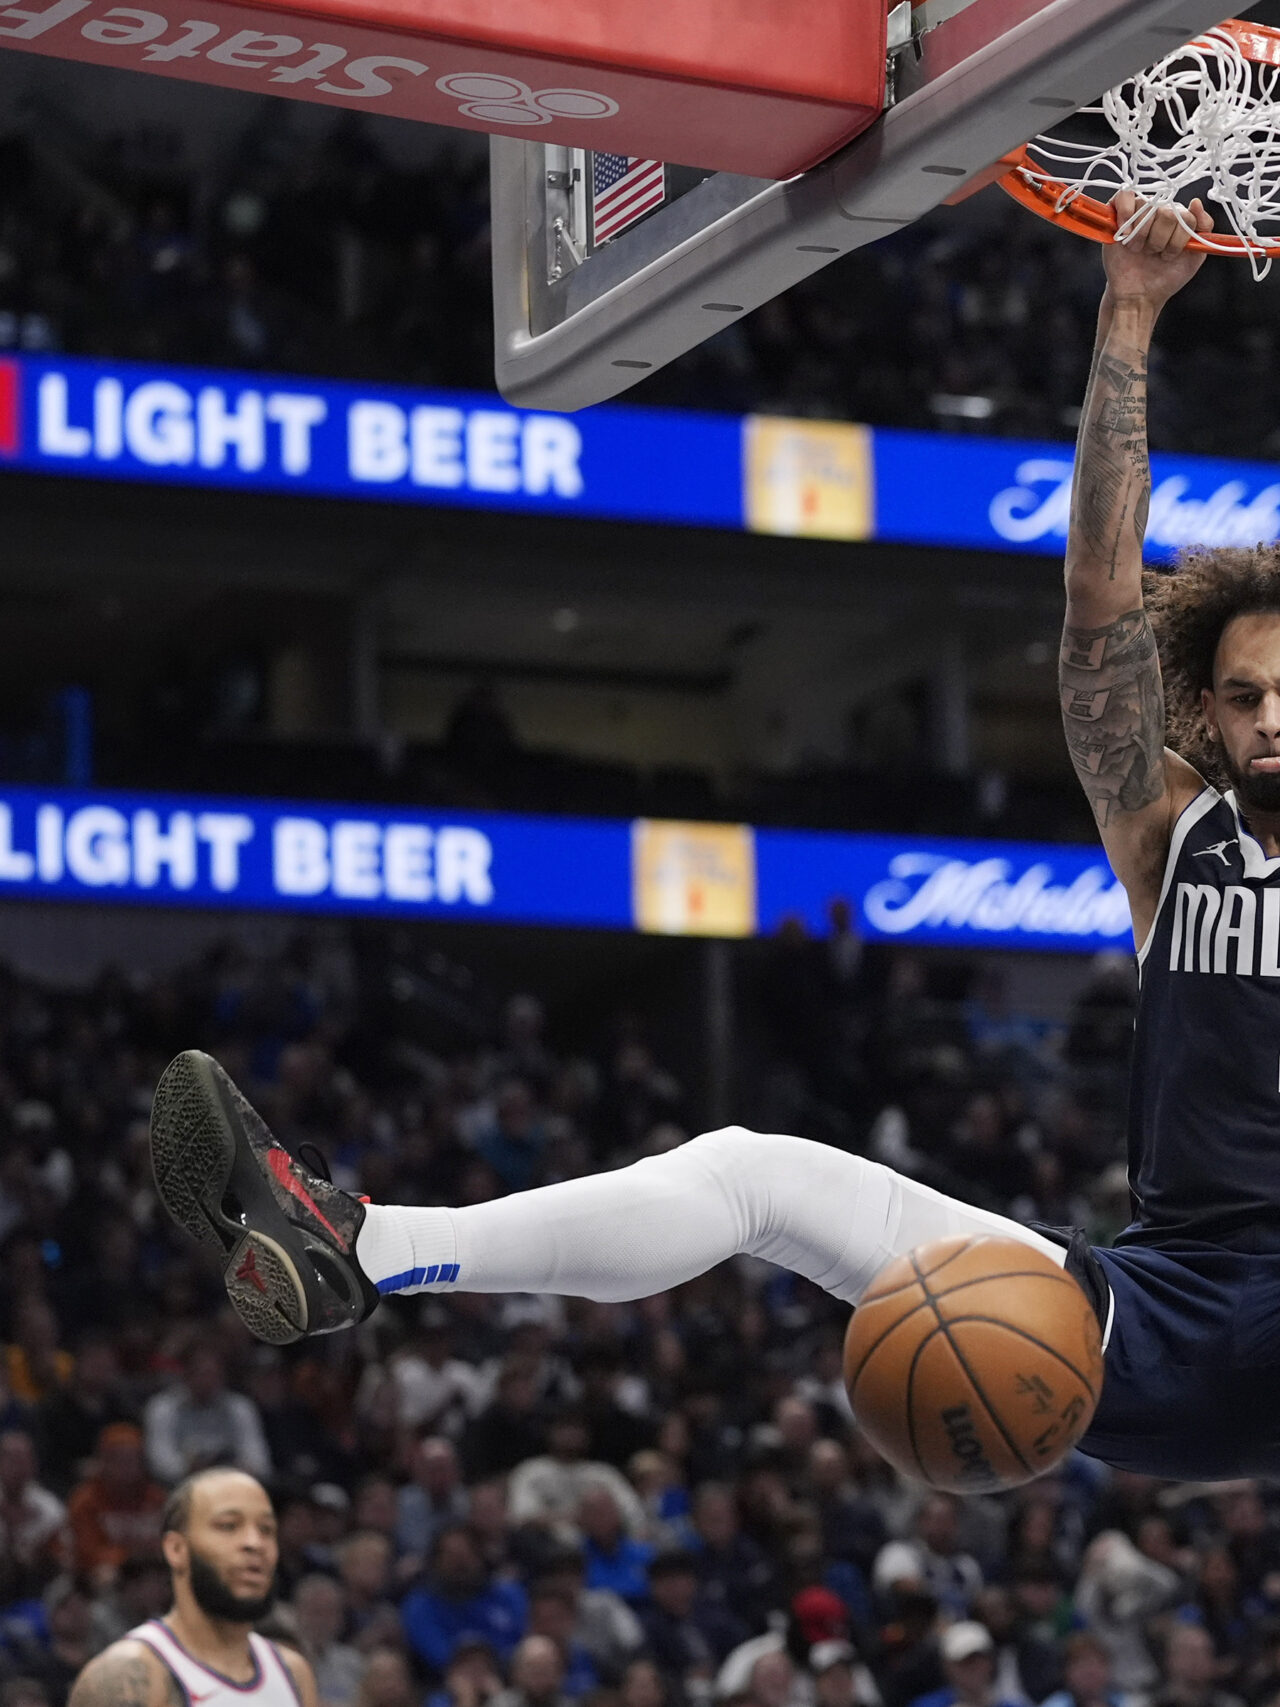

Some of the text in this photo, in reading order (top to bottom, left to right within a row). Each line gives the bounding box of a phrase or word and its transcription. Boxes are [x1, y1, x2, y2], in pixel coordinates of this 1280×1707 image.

[80, 7, 430, 97] State
[38, 372, 584, 498] LIGHT BEER
[0, 803, 494, 905] LIGHT BEER
